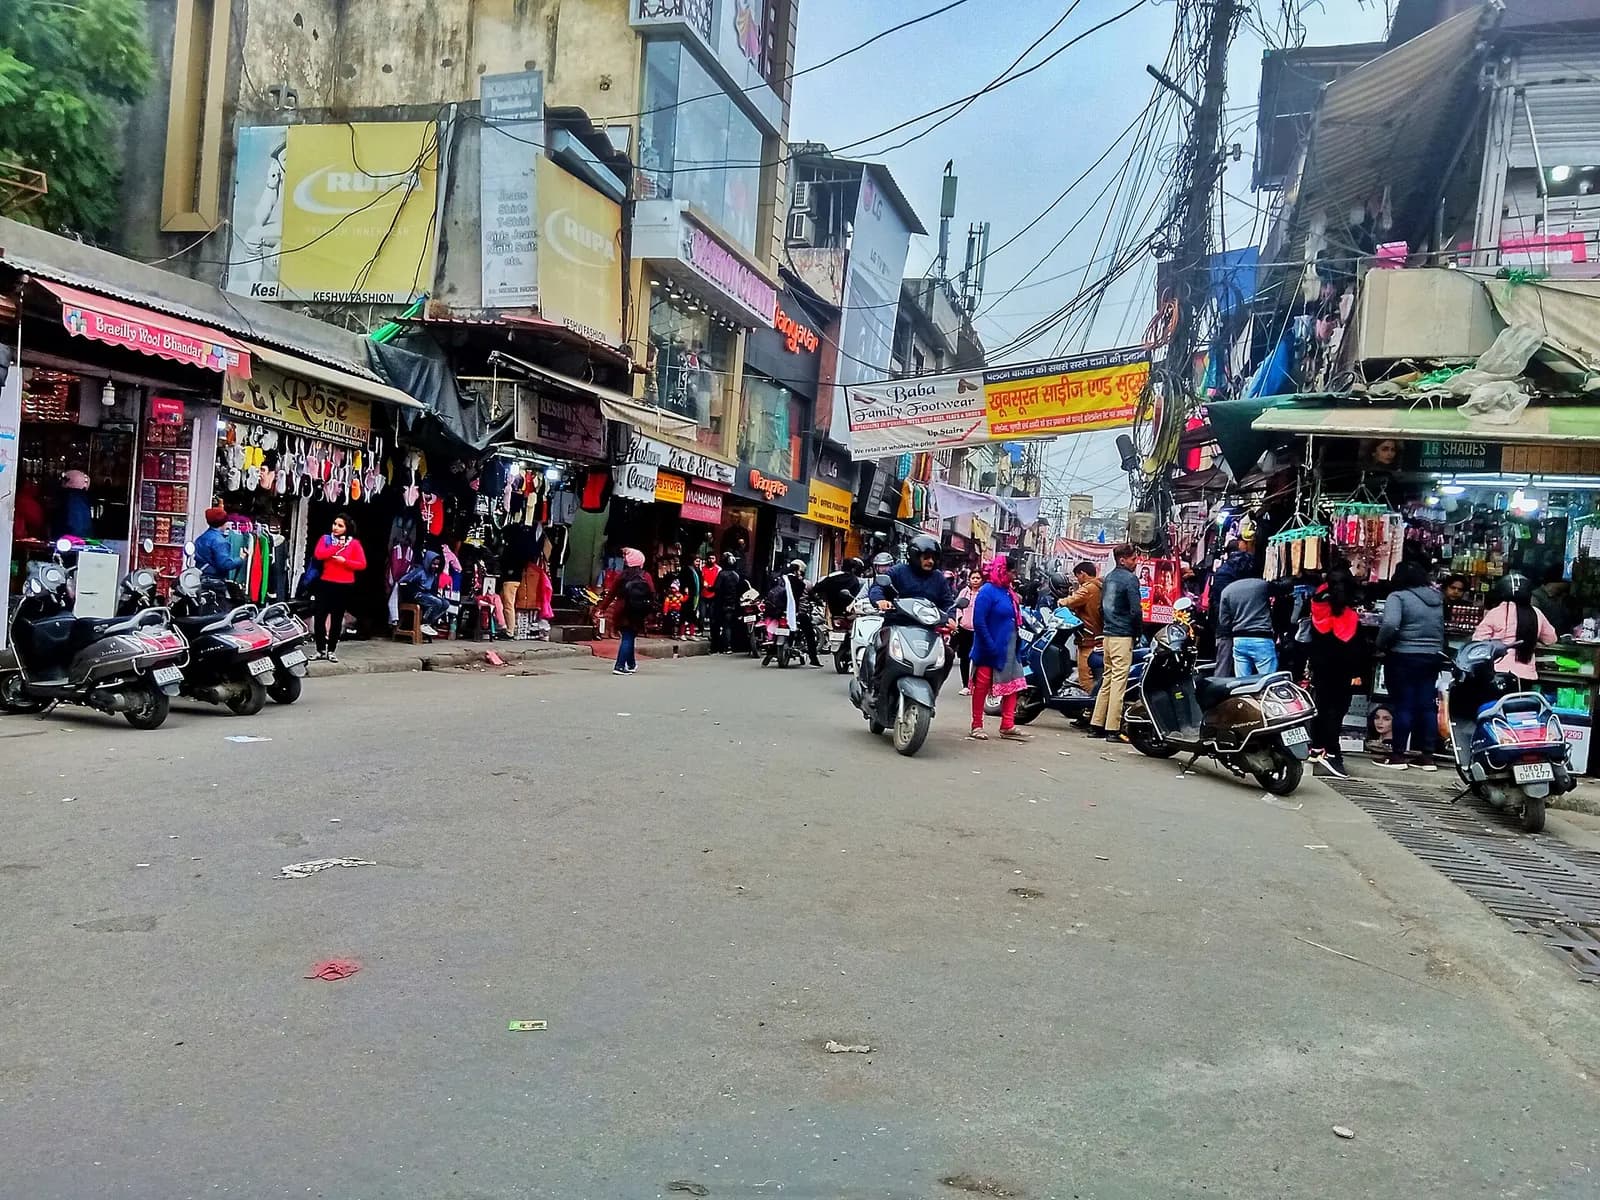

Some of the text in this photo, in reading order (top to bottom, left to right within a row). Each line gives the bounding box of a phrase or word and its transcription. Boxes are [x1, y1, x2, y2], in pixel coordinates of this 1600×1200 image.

[138, 327, 161, 348] Wool
[163, 335, 202, 359] Bhandar
[1036, 365, 1047, 376] की
[1048, 362, 1069, 375] सबसे
[1070, 359, 1088, 371] सस्ते
[1109, 352, 1122, 365] की
[885, 383, 937, 404] Baba
[987, 387, 1039, 418] खूबसूरत
[1088, 376, 1112, 399] एण्ड
[229, 408, 245, 417] Near
[854, 398, 976, 423] Family Footwear
[323, 418, 368, 441] FOOTWEAR
[926, 426, 964, 439] Up Stairs
[865, 445, 881, 454] retail
[920, 440, 936, 449] price
[1442, 441, 1487, 456] SHADES
[685, 489, 723, 510] MAHAWAR
